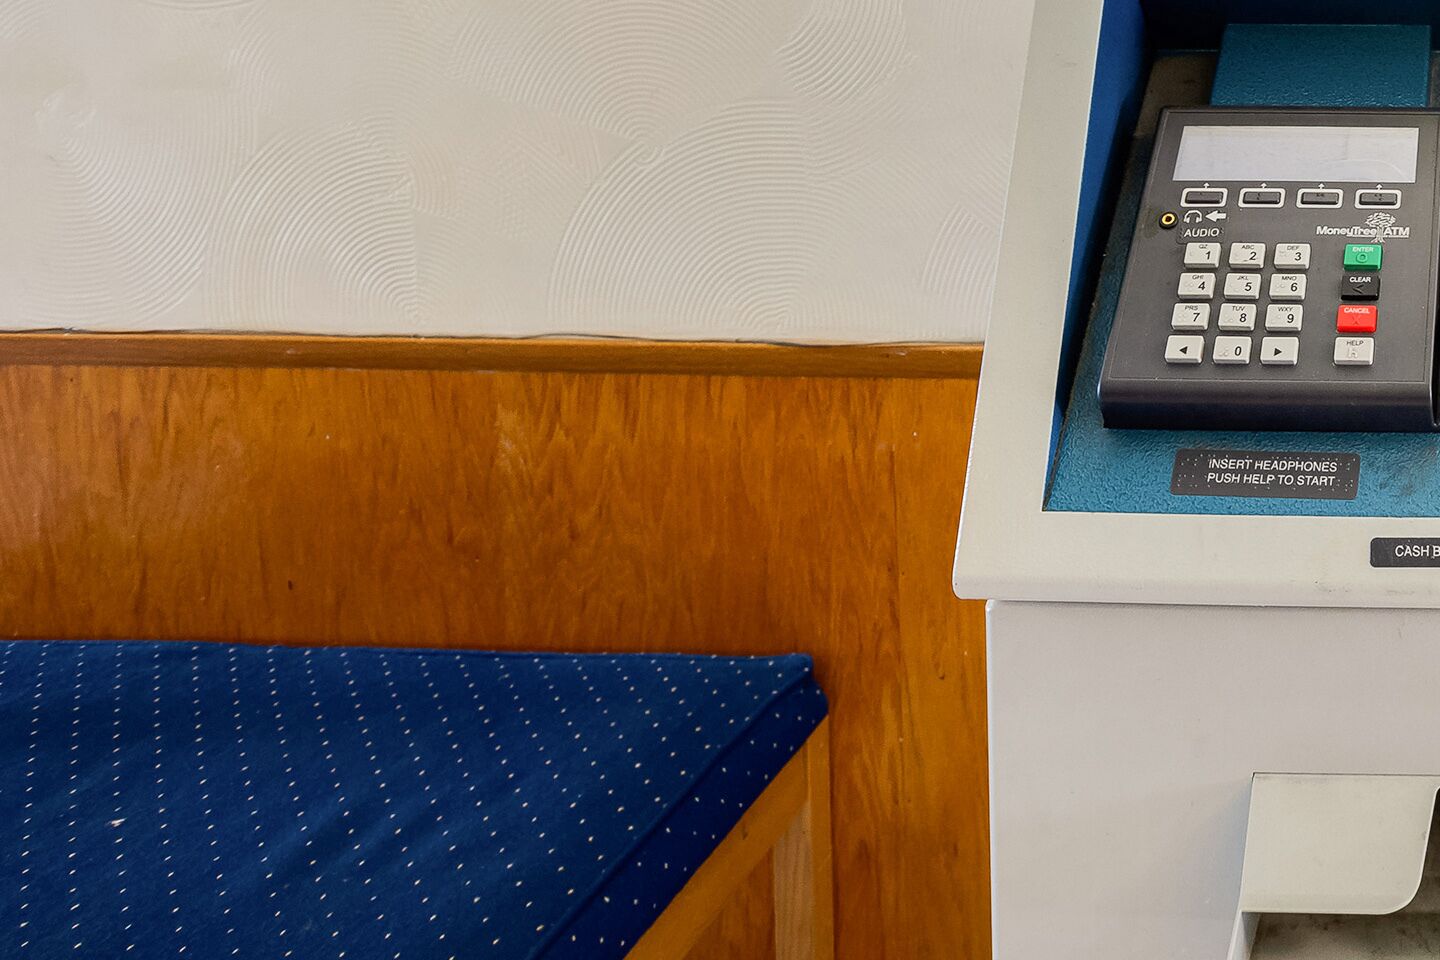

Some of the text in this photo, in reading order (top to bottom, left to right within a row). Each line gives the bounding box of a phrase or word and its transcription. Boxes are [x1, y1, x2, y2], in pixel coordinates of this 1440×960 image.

[1183, 228, 1220, 237] AUDIO
[1316, 226, 1410, 237] MoneyTree ATM
[1205, 251, 1211, 260] 1
[1249, 252, 1257, 261] 2
[1294, 252, 1302, 261] 3
[1198, 281, 1206, 291] 4
[1244, 282, 1252, 292] 5
[1290, 282, 1298, 292] 6
[1193, 312, 1200, 322] 7
[1239, 313, 1247, 323] 8
[1286, 313, 1295, 324] 9
[1234, 346, 1242, 356] 0
[1208, 458, 1338, 472] INSERT HEADPHONES
[1207, 472, 1336, 486] PUSH HELP TO START
[1394, 545, 1430, 557] CASH
